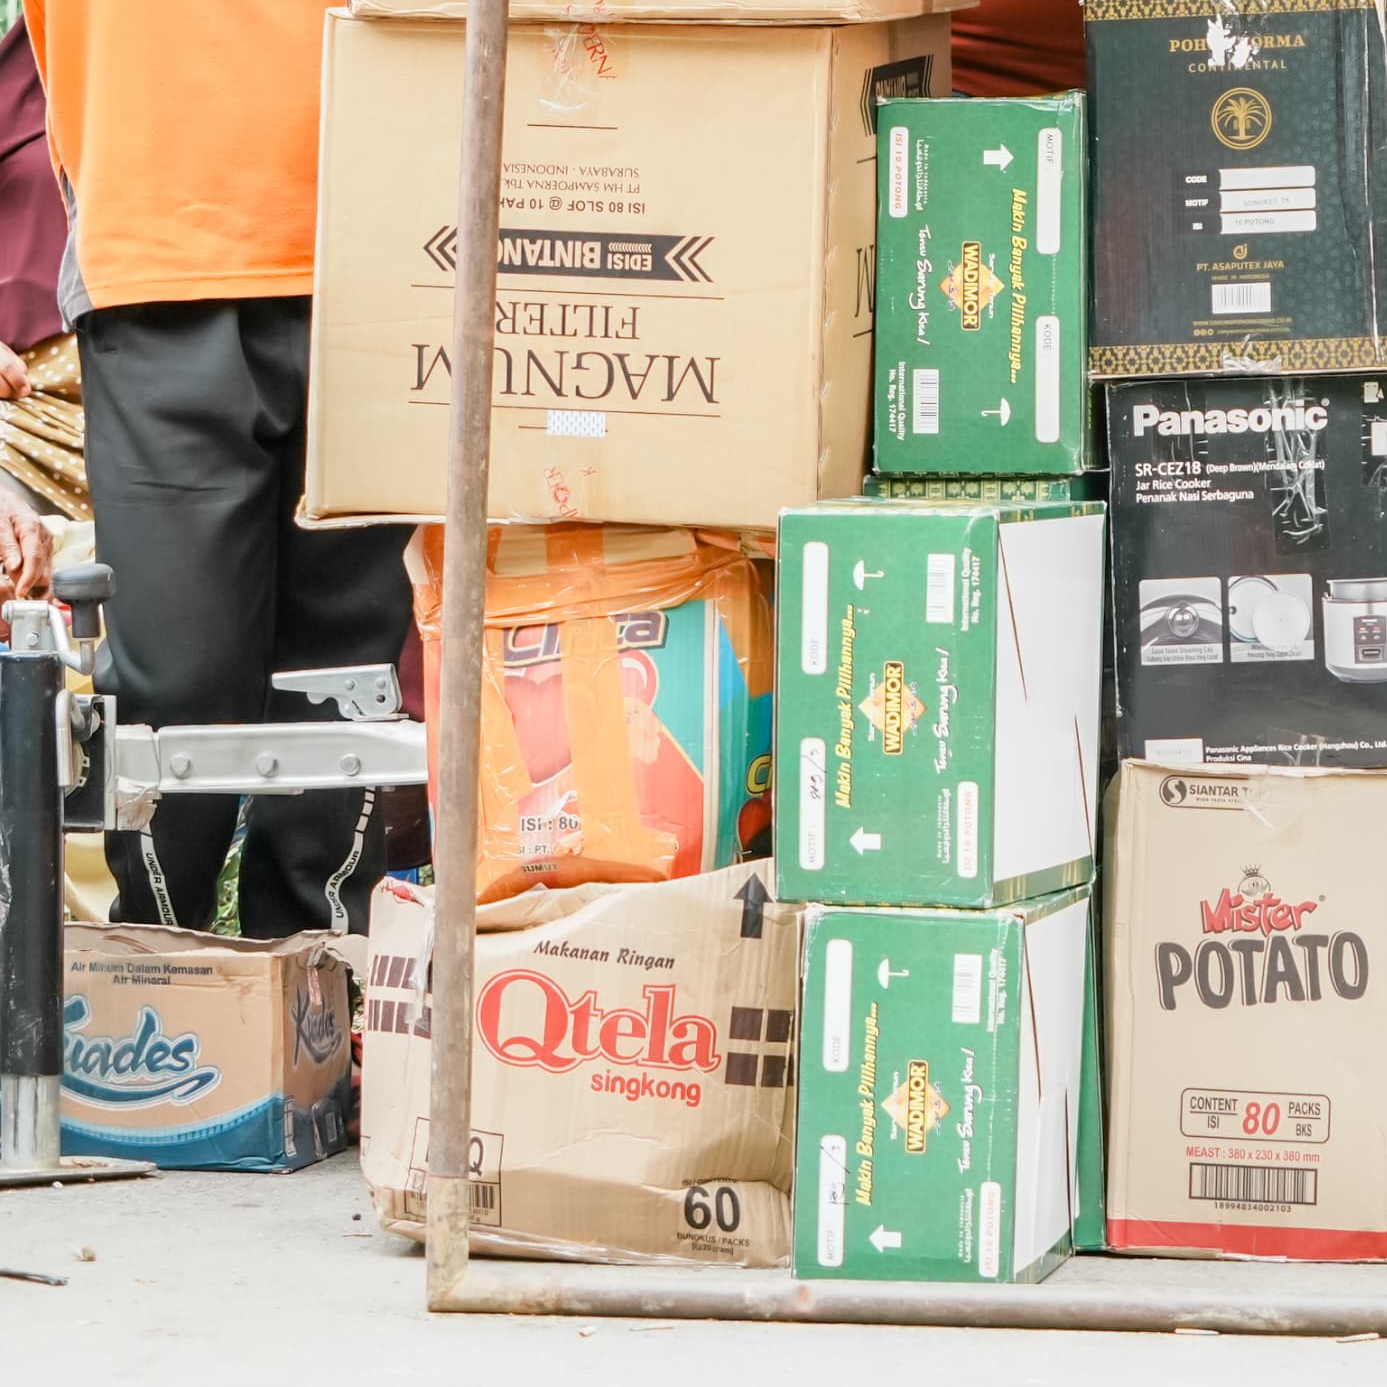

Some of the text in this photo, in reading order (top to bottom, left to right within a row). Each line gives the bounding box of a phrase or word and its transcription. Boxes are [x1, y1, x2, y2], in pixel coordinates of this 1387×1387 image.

[1045, 134, 1054, 164] MOTIF
[503, 163, 639, 178] SURABAYA INDONESIA
[527, 180, 640, 193] PT HM SAMPOERNA
[567, 200, 645, 214] ISI 80 SLOF
[1010, 188, 1027, 290] Makin Banyak
[608, 253, 652, 271] EDISI
[1197, 261, 1284, 271] PT. ASAPUTEX JAYA
[964, 244, 978, 327] WADIMOR
[496, 301, 640, 340] FILTER
[1043, 324, 1052, 350] KODE
[896, 362, 906, 440] International Quality
[1133, 399, 1328, 436] Panasonic
[1135, 461, 1201, 476] SR-CEZ18
[1136, 479, 1211, 491] Jar Rice Cooker
[1136, 491, 1254, 503] Penanak Nasi Serbaguna
[886, 665, 901, 751] WADIMOR
[835, 703, 854, 808] Makin Banyak
[1188, 784, 1239, 797] SIANTAR
[145, 852, 162, 884] UNDER
[1201, 888, 1317, 935] Mister
[70, 962, 213, 975] Air Kemasan
[533, 940, 676, 971] Makanan Ringan
[1156, 931, 1369, 1011] POTATO
[477, 969, 721, 1074] Qtela
[591, 1071, 702, 1107] singkong
[908, 1064, 925, 1150] WADIMOR
[1190, 1097, 1321, 1135] CONTENT 80 PACKS
[856, 1100, 876, 1157] Banyak
[1208, 1116, 1312, 1136] ISI BKS
[1186, 1146, 1320, 1162] MEAST 380 230 380 mm
[683, 1185, 741, 1233] 60
